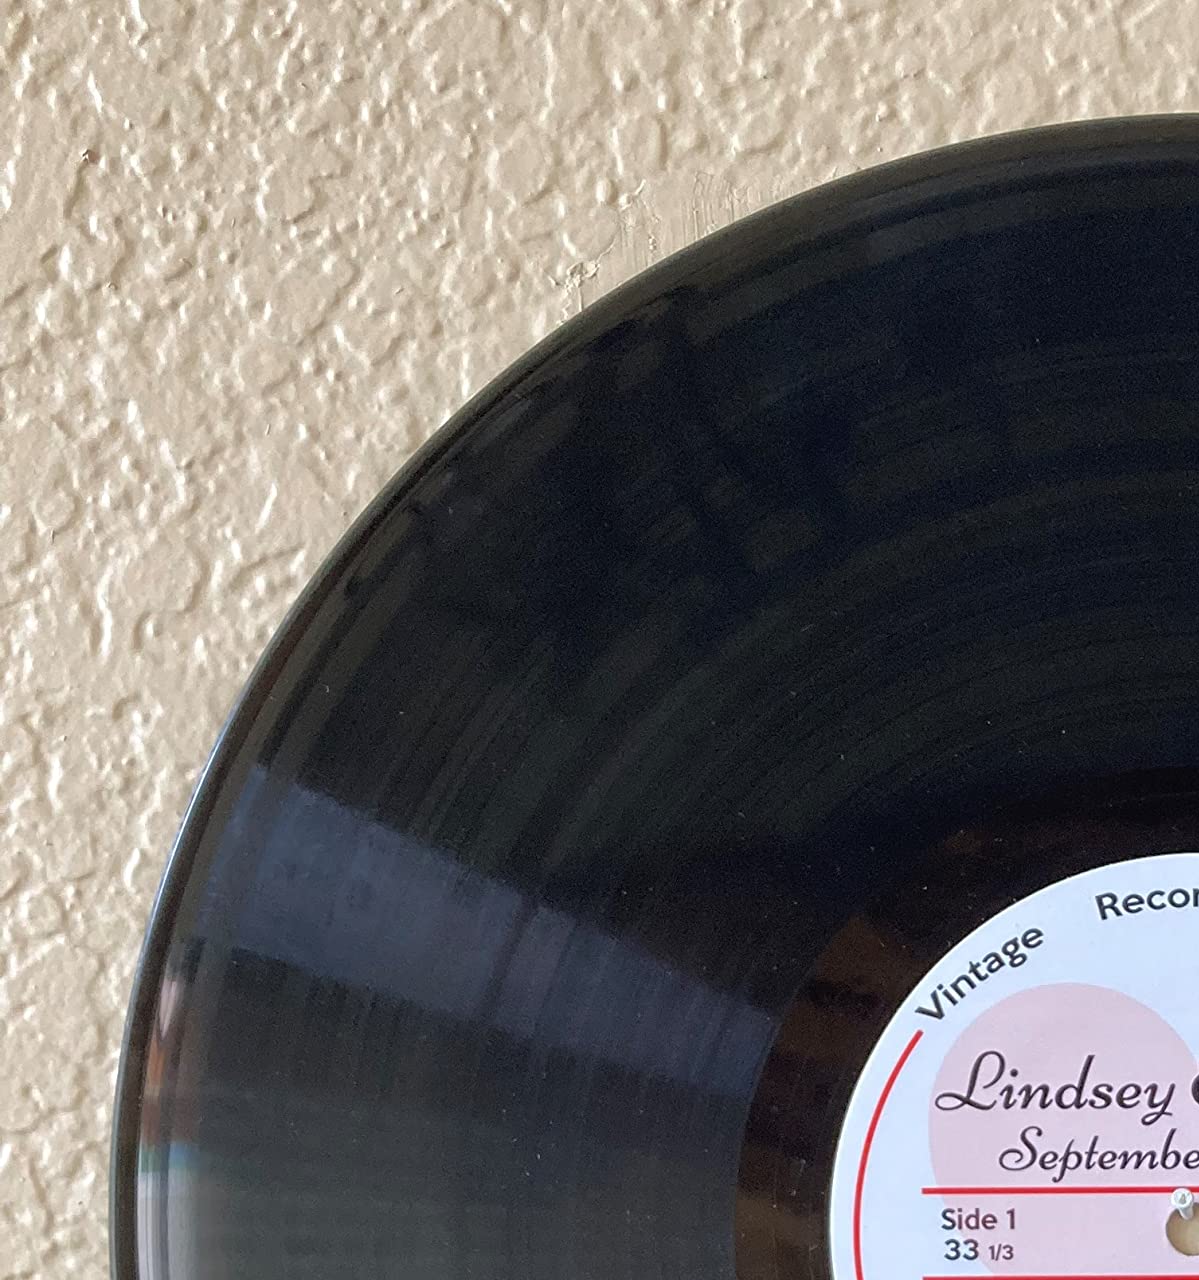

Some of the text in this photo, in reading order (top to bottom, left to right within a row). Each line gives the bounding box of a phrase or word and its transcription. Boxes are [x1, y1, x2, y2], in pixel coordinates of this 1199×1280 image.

[914, 928, 1044, 1020] Vintage
[934, 1050, 1176, 1126] Lindsey
[941, 1207, 1015, 1231] Side 1
[944, 1238, 1014, 1261] 33 1/3
